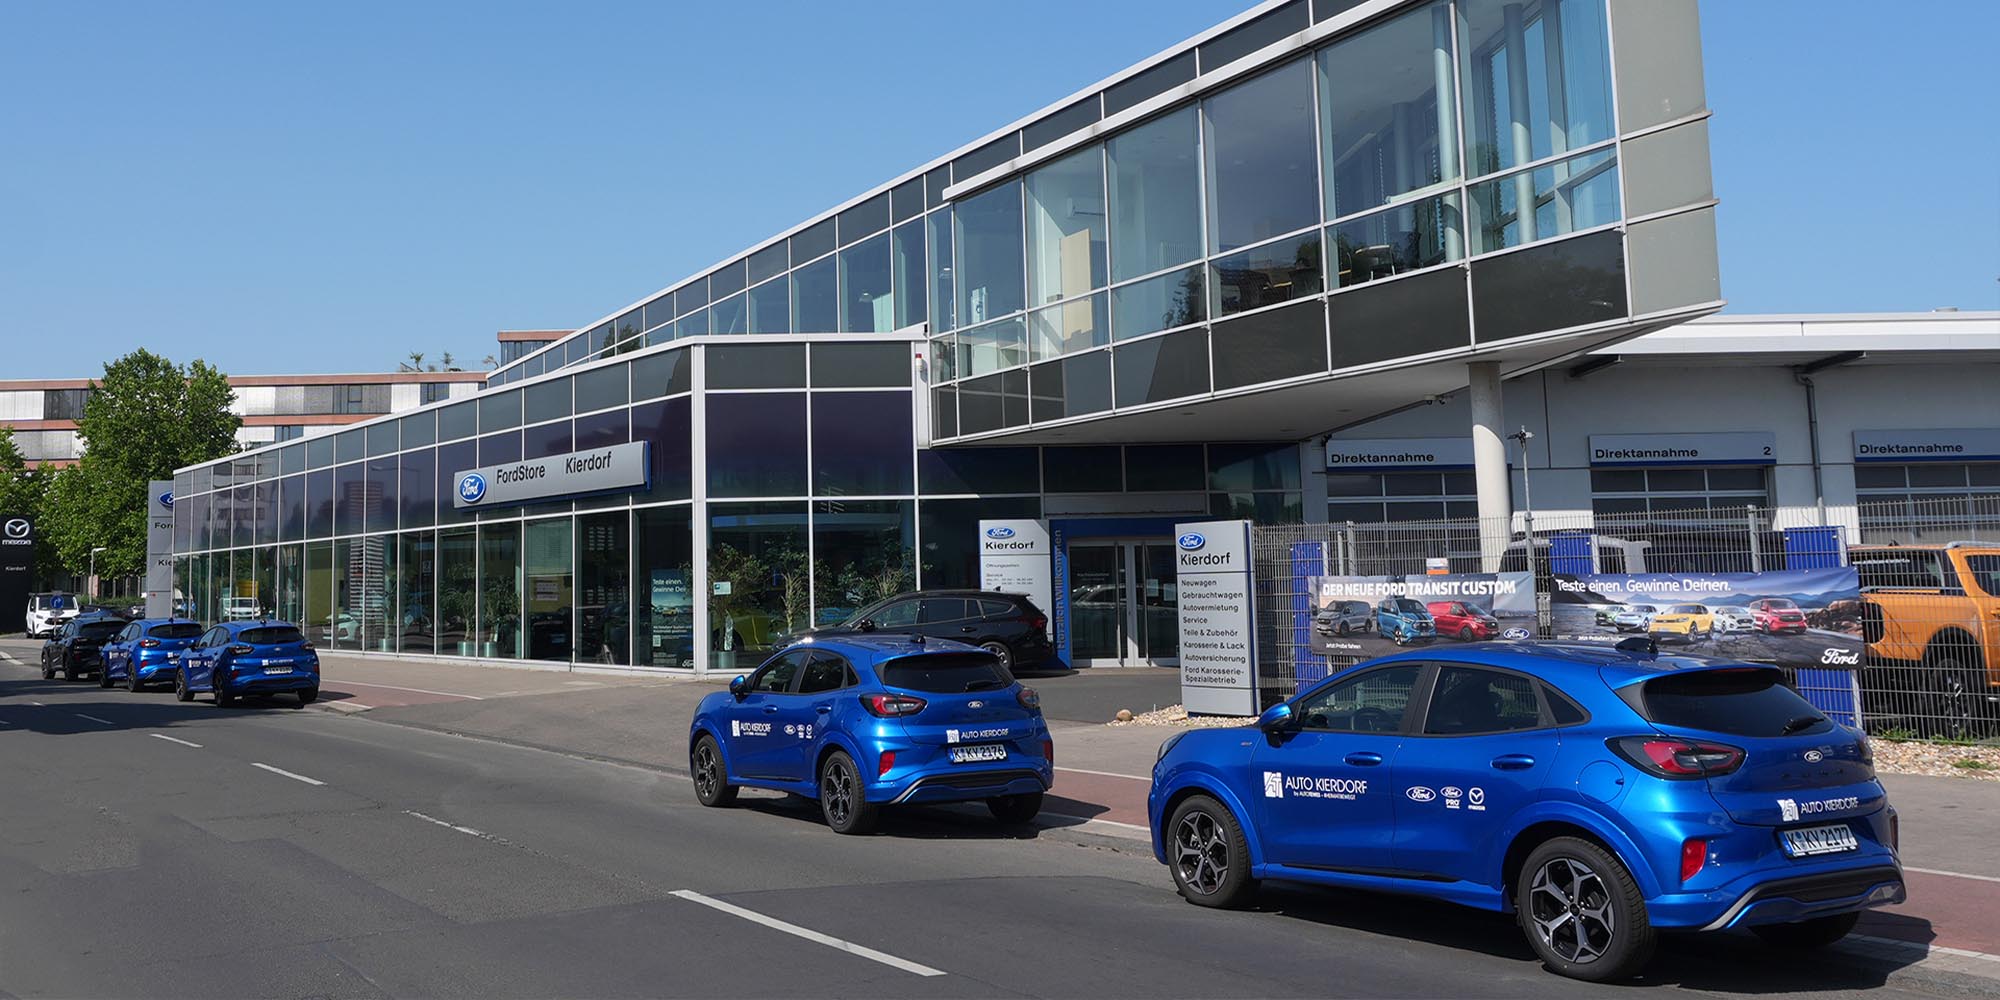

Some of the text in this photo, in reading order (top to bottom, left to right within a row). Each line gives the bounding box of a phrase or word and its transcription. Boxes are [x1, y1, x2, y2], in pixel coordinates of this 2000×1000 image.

[1595, 446, 1772, 459] Direktannahme 2
[1859, 443, 1963, 454] Direktannahme
[1331, 452, 1434, 464] Direktannahme
[496, 451, 612, 484] FordStore Kierdorf
[985, 540, 1035, 550] Kierdorf
[1180, 552, 1231, 566] Kierdorf
[1180, 579, 1217, 588] Neuwagen
[1322, 580, 1516, 596] DER NEUE FORD TRANSIT CUSTOM
[1556, 577, 1732, 593] Teste einen. Gewinne Deinen.
[1181, 591, 1243, 600] Gebrauchtwagen
[1182, 604, 1239, 613] Autovermietung
[1206, 629, 1238, 637] Zubehör
[1226, 642, 1245, 650] Lack
[1184, 654, 1246, 664] Autoversicherung
[1821, 647, 1860, 665] Ford
[1184, 666, 1245, 676] Ford Karosserie-
[1184, 674, 1236, 685] Spezialbetrieb
[960, 728, 1009, 740] AUTO KIERDORF
[1285, 776, 1368, 794] AUTO KIERDORF
[1800, 796, 1859, 814] AUTO KIERDORF
